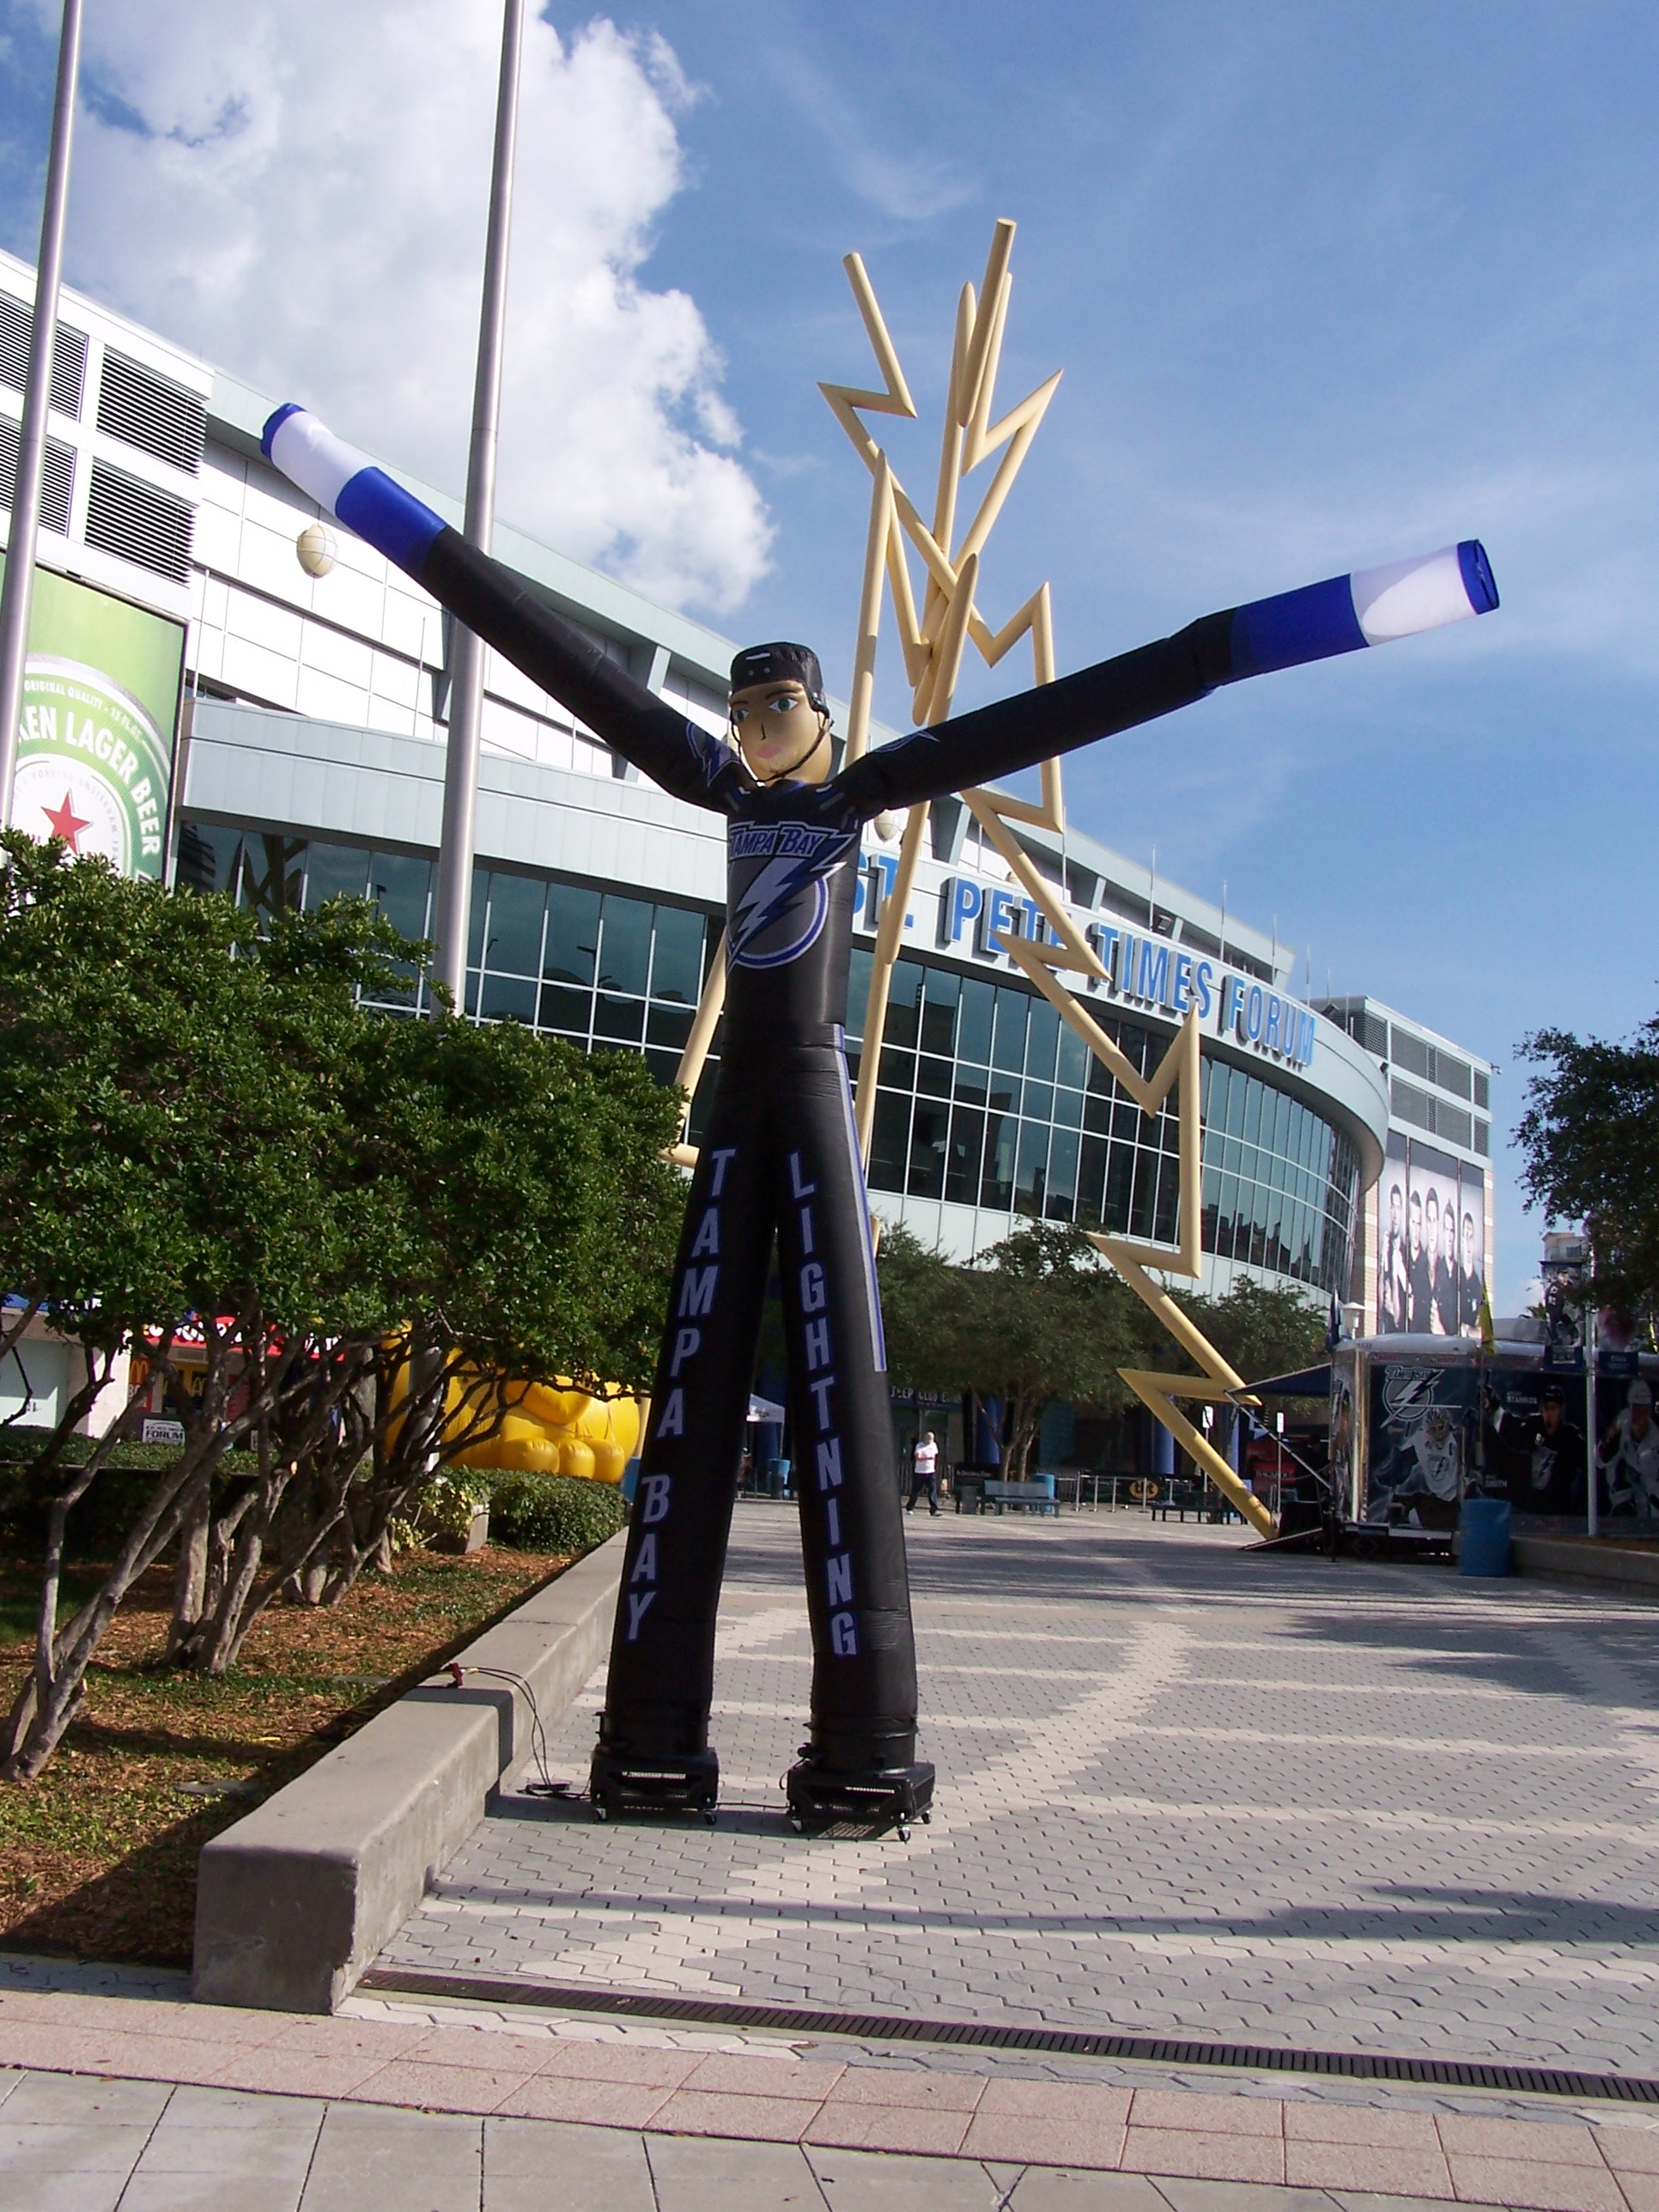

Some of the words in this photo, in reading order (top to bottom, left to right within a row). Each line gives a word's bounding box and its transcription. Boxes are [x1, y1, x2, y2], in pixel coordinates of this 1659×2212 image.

[68, 688, 104, 710] QUALITY
[64, 711, 139, 784] LAGER
[131, 781, 161, 856] BEER
[729, 827, 778, 860] TAMPA
[775, 825, 828, 858] BAY
[1095, 922, 1213, 1020] TIMES
[1226, 974, 1316, 1067] FORUM
[657, 1147, 737, 1439] TAMPA
[145, 1430, 184, 1440] FORUM
[789, 1151, 858, 1656] LIGHTNING
[626, 1474, 672, 1641] BAY
